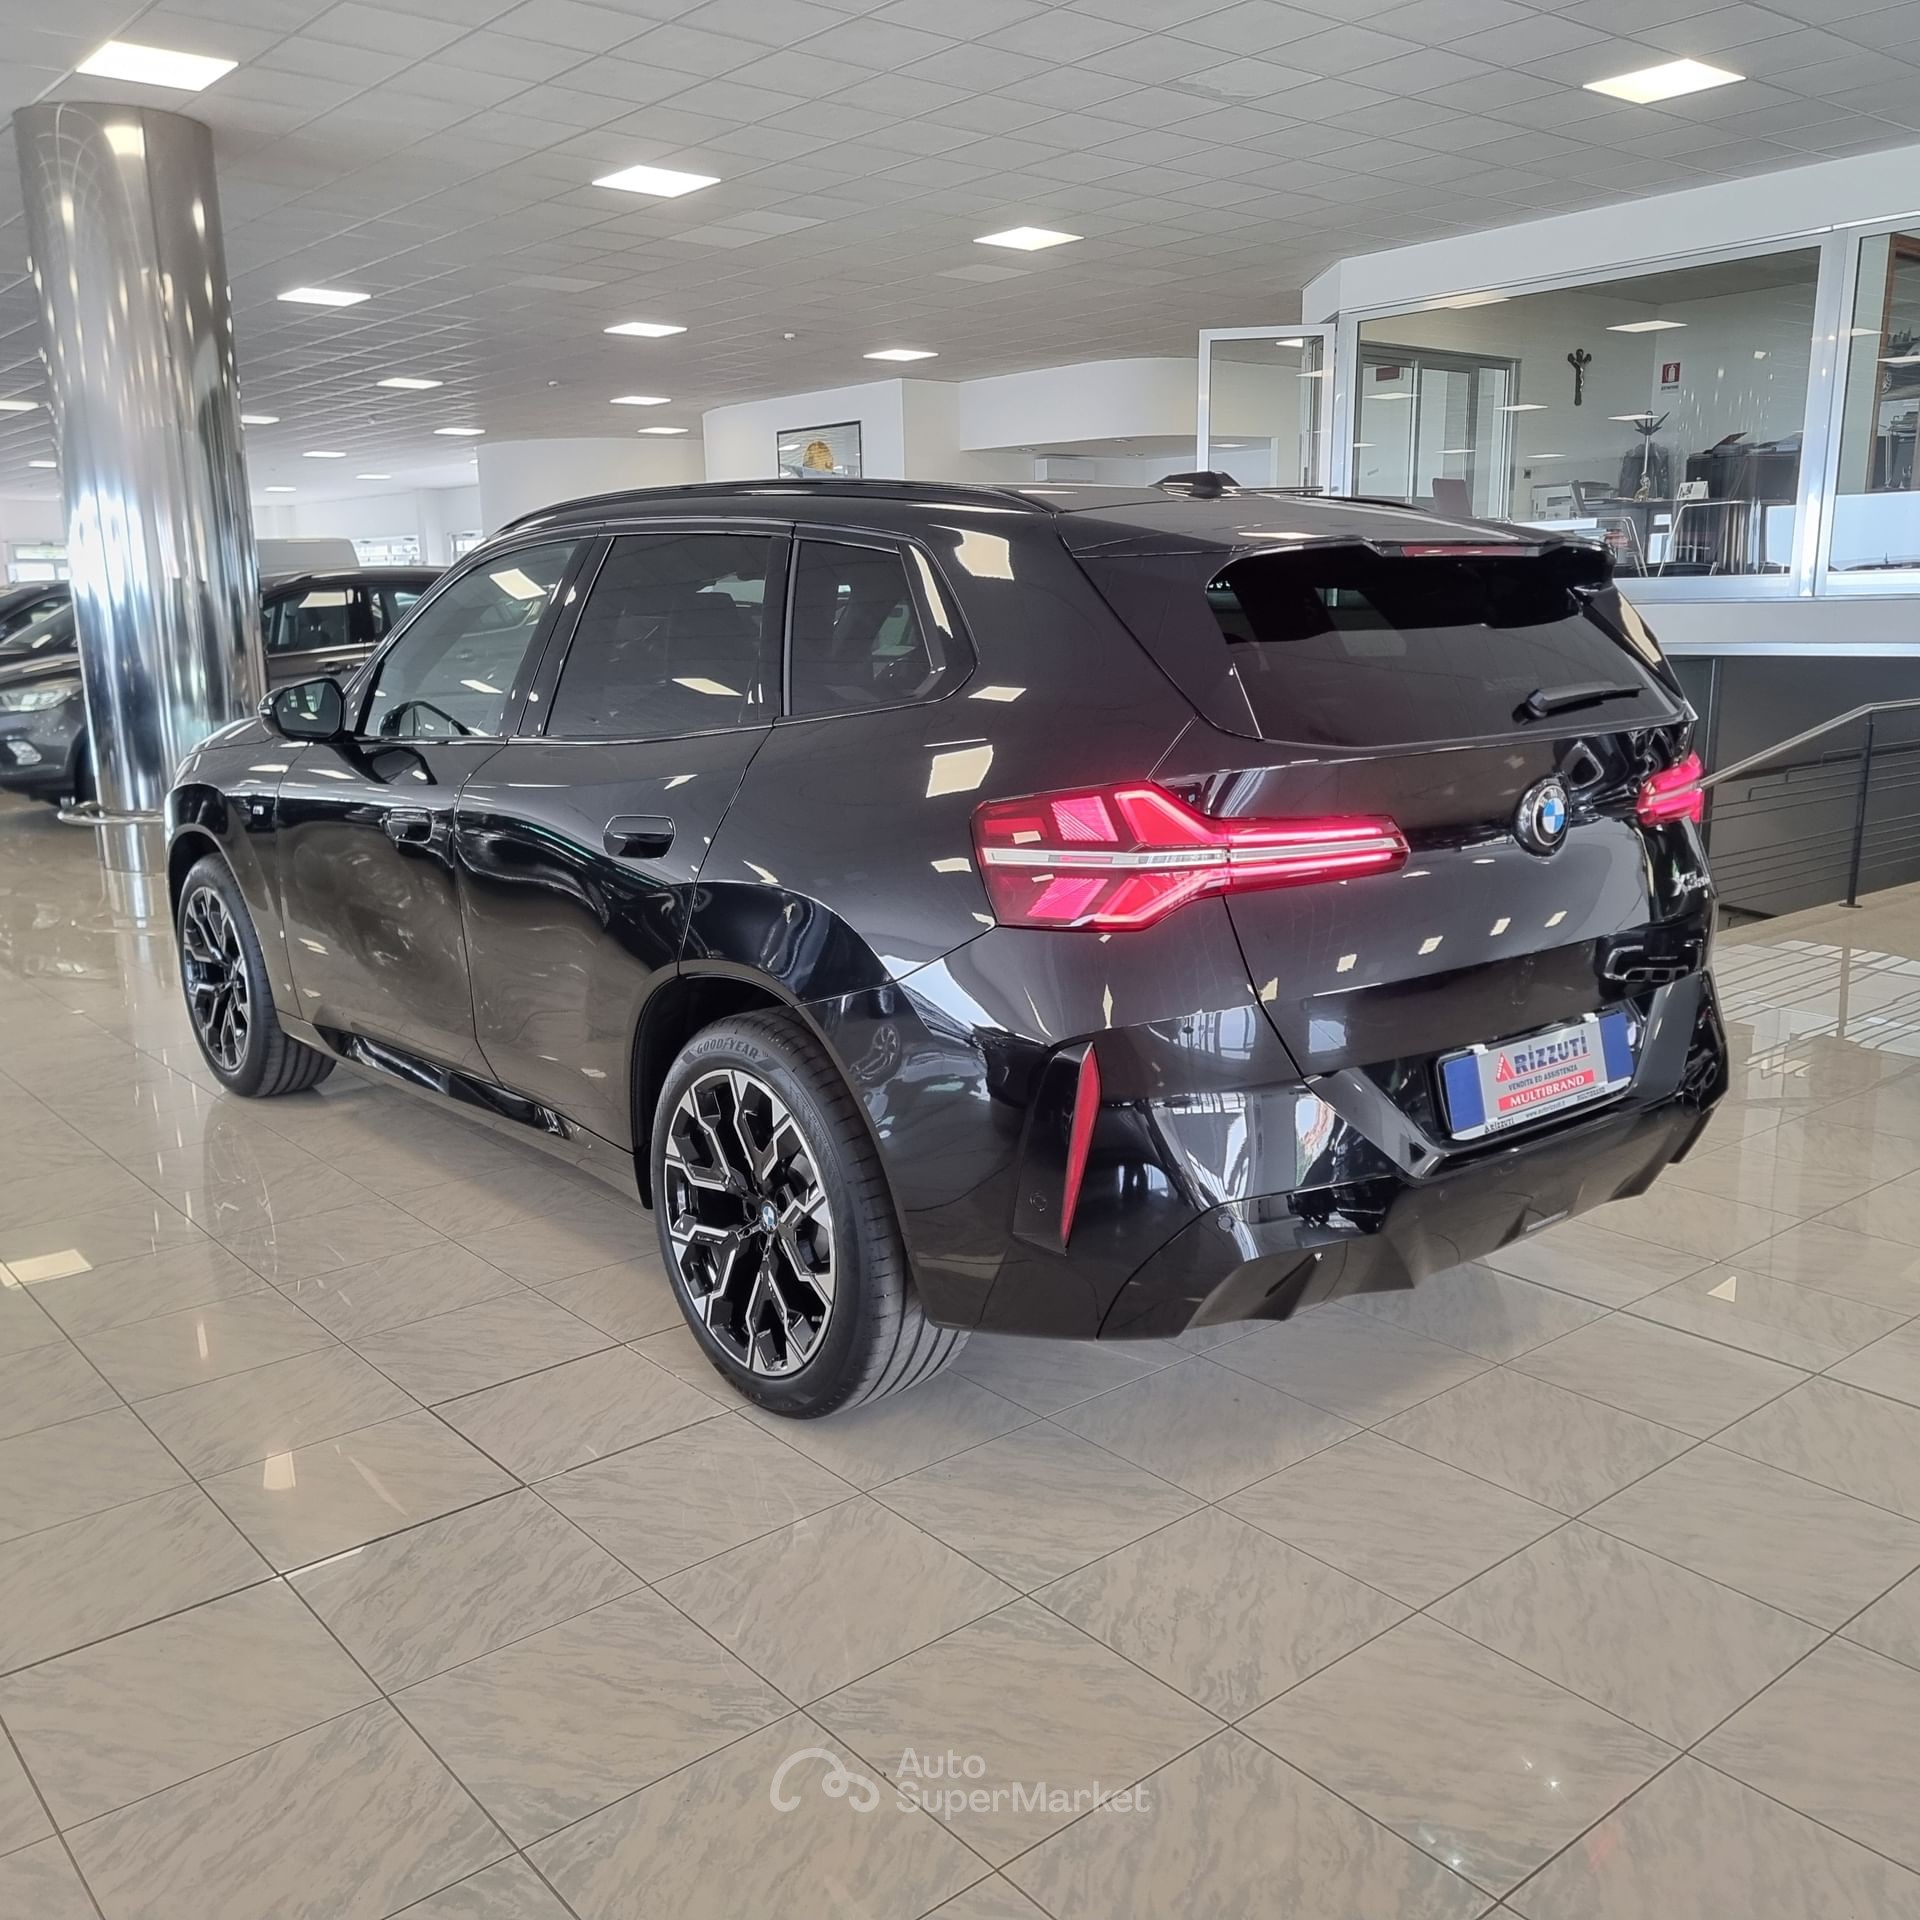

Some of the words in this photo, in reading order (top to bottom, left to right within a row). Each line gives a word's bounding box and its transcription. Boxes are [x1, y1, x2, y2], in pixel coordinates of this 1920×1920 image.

[696, 1037, 759, 1060] GOODYEAR
[1508, 1078, 1534, 1092] VENDITA
[1535, 1076, 1543, 1085] ED
[1544, 1064, 1578, 1081] ASSISTENZA
[1509, 1075, 1585, 1108] MULTIBRAND
